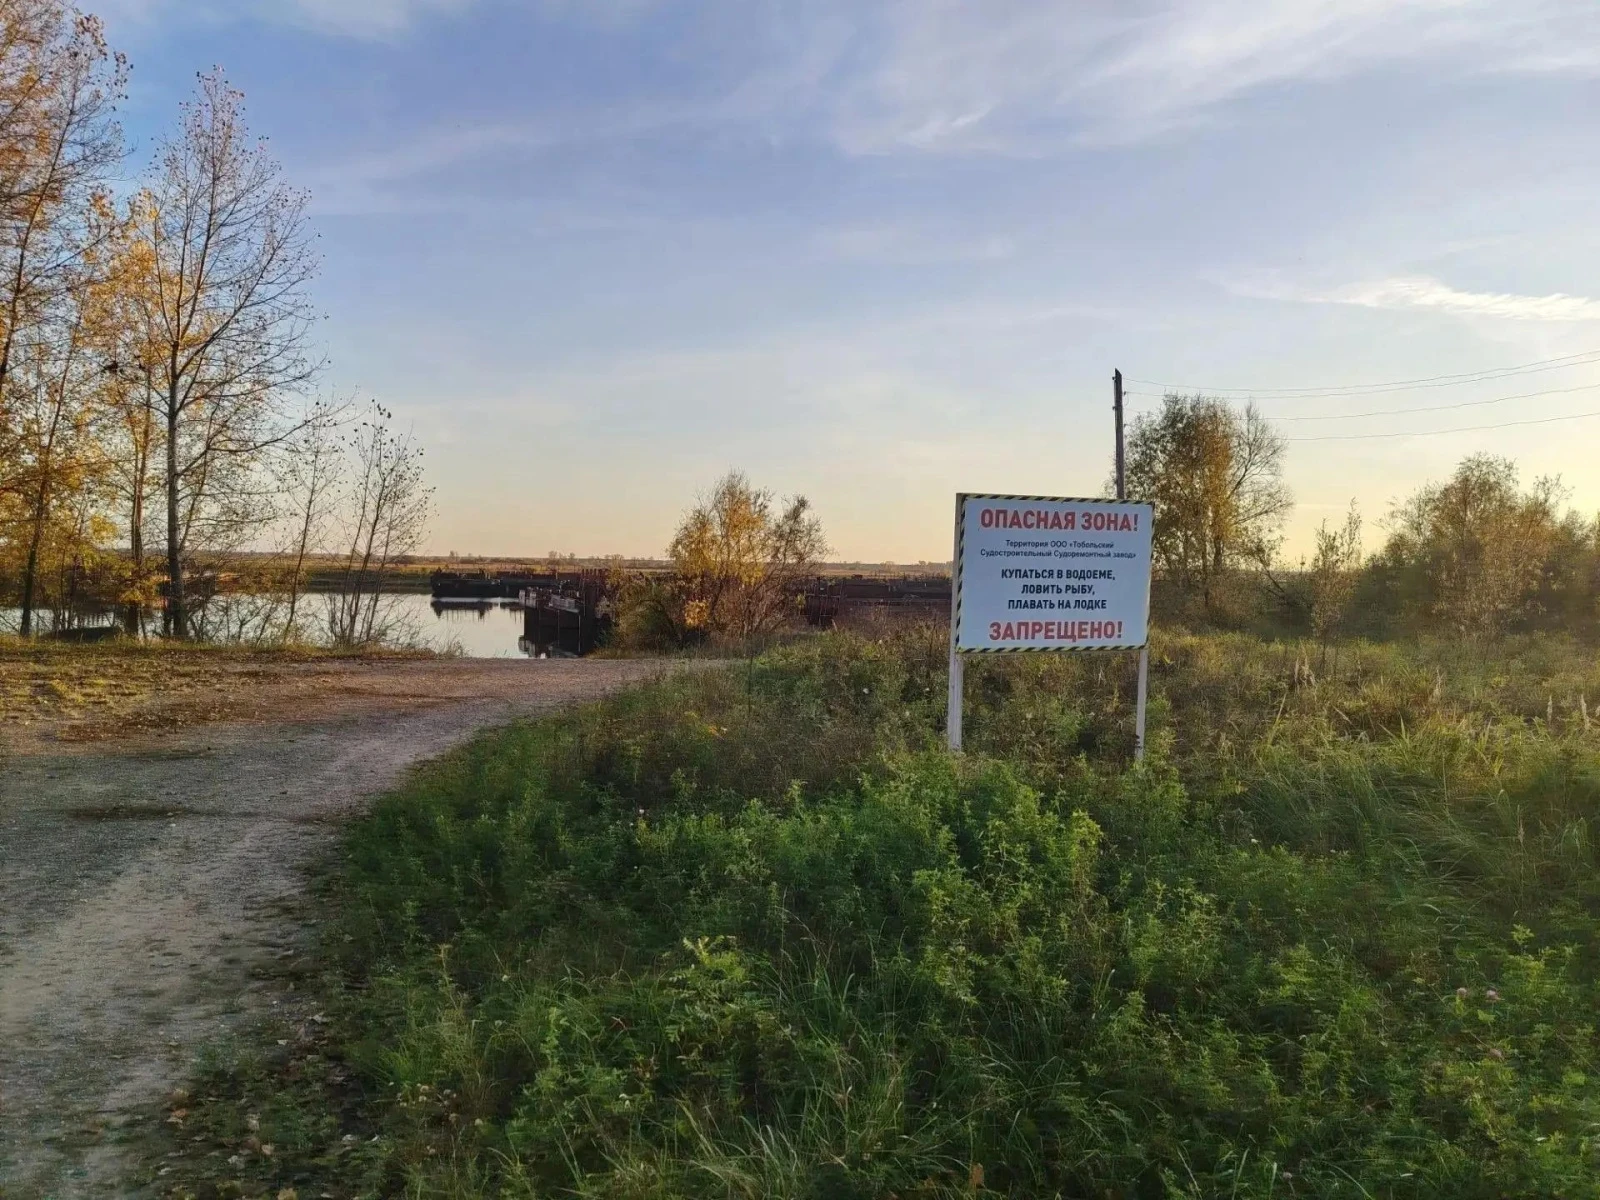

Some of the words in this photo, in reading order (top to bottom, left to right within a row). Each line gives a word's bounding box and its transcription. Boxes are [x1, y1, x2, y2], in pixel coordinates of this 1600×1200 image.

[981, 509, 1075, 530] ОПАСНАЯ
[1081, 512, 1138, 531] ЗОНА!
[1006, 540, 1048, 548] Территория
[1001, 569, 1053, 579] КУПАТЬСЯ
[1057, 570, 1063, 579] В
[1066, 570, 1115, 580] ВОДОЕМЕ,
[1021, 585, 1062, 593] ЛОВИТЬ
[1065, 585, 1094, 595] РЫБУ,
[1008, 600, 1055, 609] ПЛАВАТЬ
[1058, 600, 1070, 609] НА
[1074, 600, 1107, 610] ЛОДКЕ
[989, 621, 1122, 642] ЗАПРЕЩЕНО!
